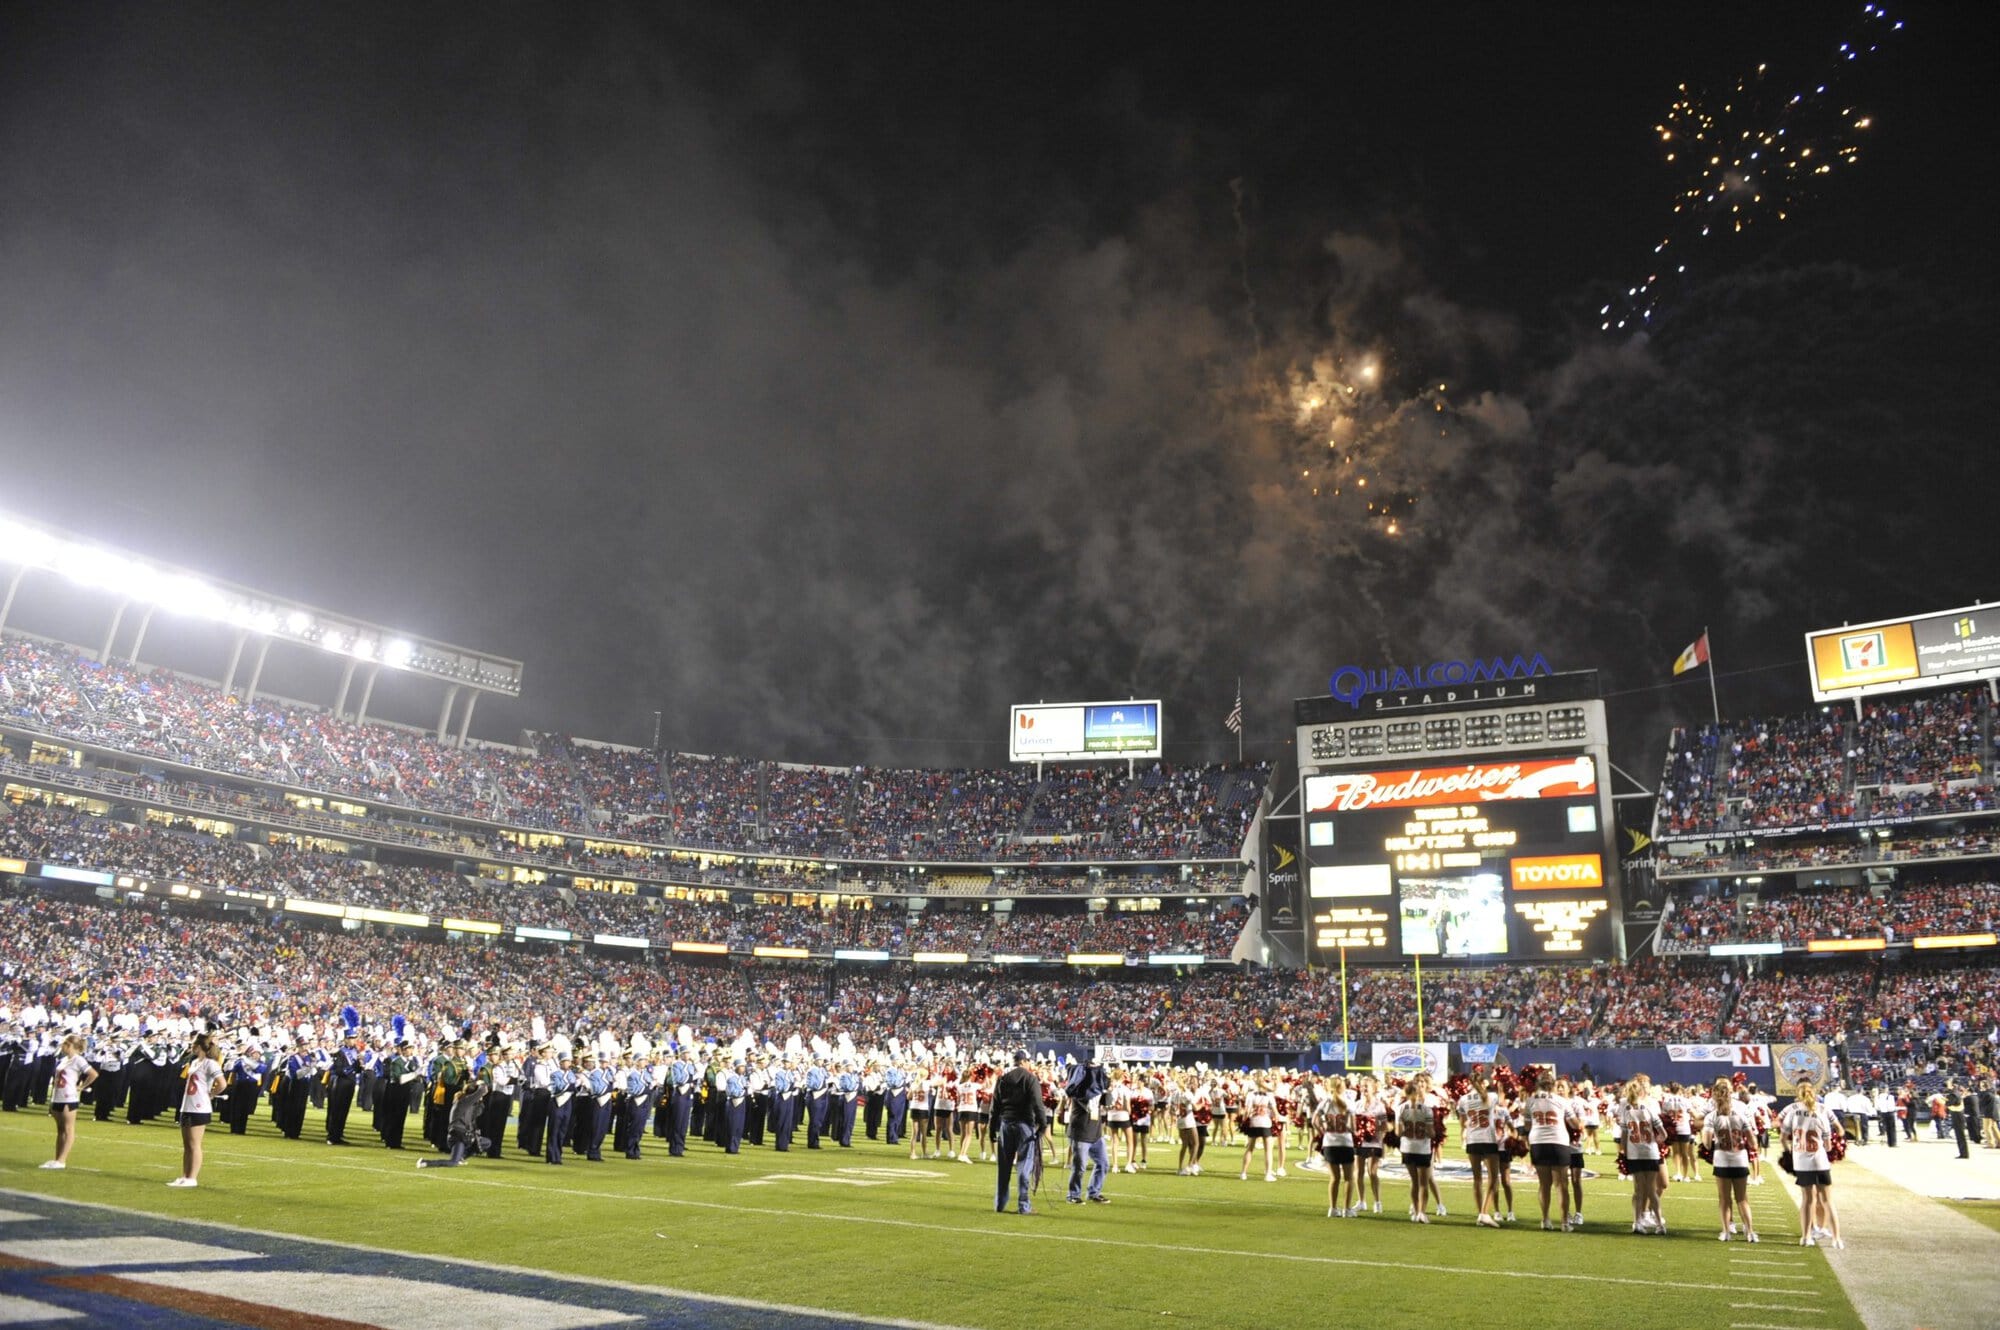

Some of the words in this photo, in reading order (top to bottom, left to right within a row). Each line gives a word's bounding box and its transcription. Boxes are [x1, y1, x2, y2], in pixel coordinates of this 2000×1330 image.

[1329, 652, 1553, 709] QUALCOMM
[1376, 684, 1536, 708] STADIUM
[1019, 737, 1054, 746] Union
[1330, 765, 1521, 811] Budweiser
[1825, 821, 1853, 830] OCATION
[1854, 820, 1867, 828] AND
[1515, 863, 1598, 882] TOYOTA
[1620, 858, 1656, 873] Sprint
[1268, 872, 1299, 885] Sprint
[1415, 1048, 1429, 1058] LIE
[1739, 1046, 1761, 1065] N
